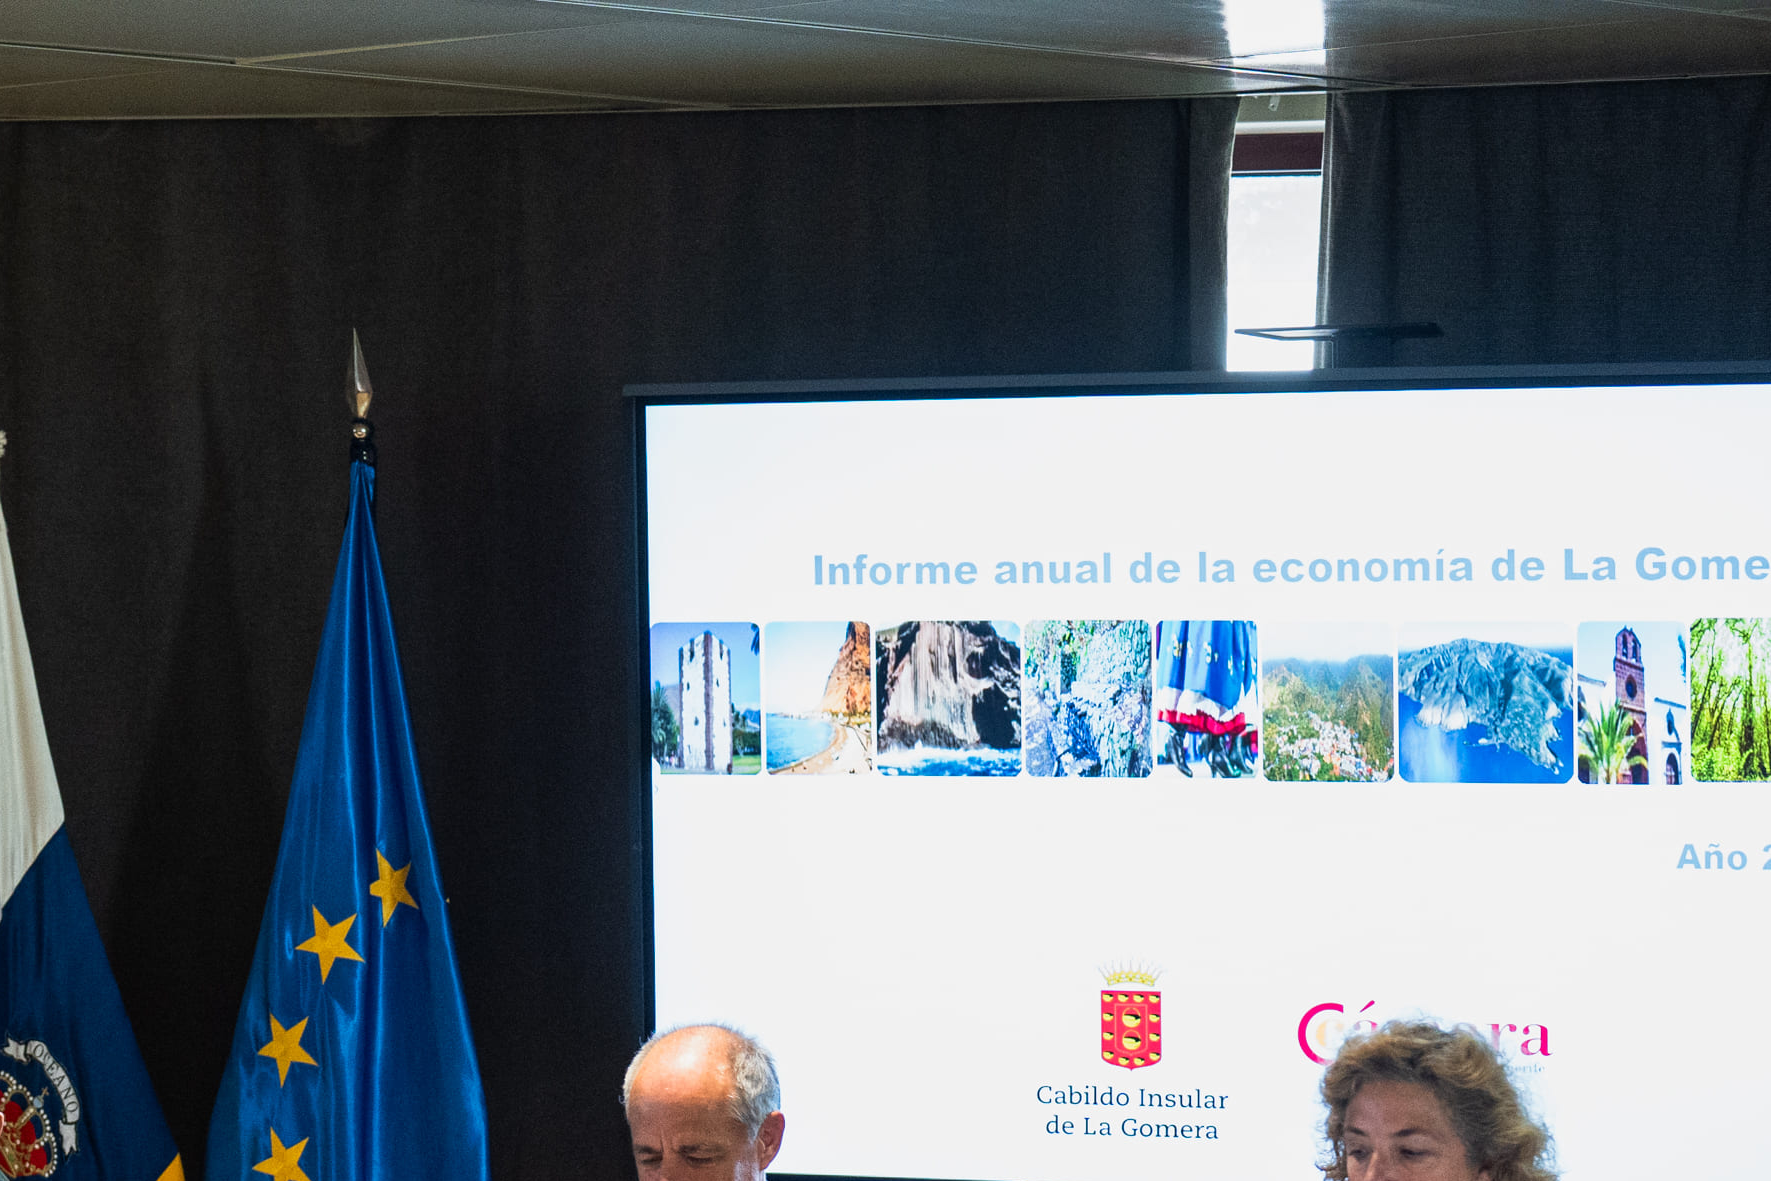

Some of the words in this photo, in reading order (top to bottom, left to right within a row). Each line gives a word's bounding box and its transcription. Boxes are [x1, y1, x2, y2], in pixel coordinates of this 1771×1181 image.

[813, 554, 978, 586] Informe
[994, 552, 1112, 585] anual
[1129, 552, 1181, 584] de
[1198, 551, 1236, 583] la
[1252, 549, 1474, 583] economía
[1491, 549, 1545, 582] de
[1564, 548, 1617, 581] La
[1676, 843, 1748, 870] Año
[1036, 1085, 1130, 1106] Cabildo
[1139, 1088, 1229, 1109] Insular
[1046, 1115, 1075, 1135] de
[1083, 1117, 1112, 1136] La
[1121, 1118, 1219, 1139] Gomera
